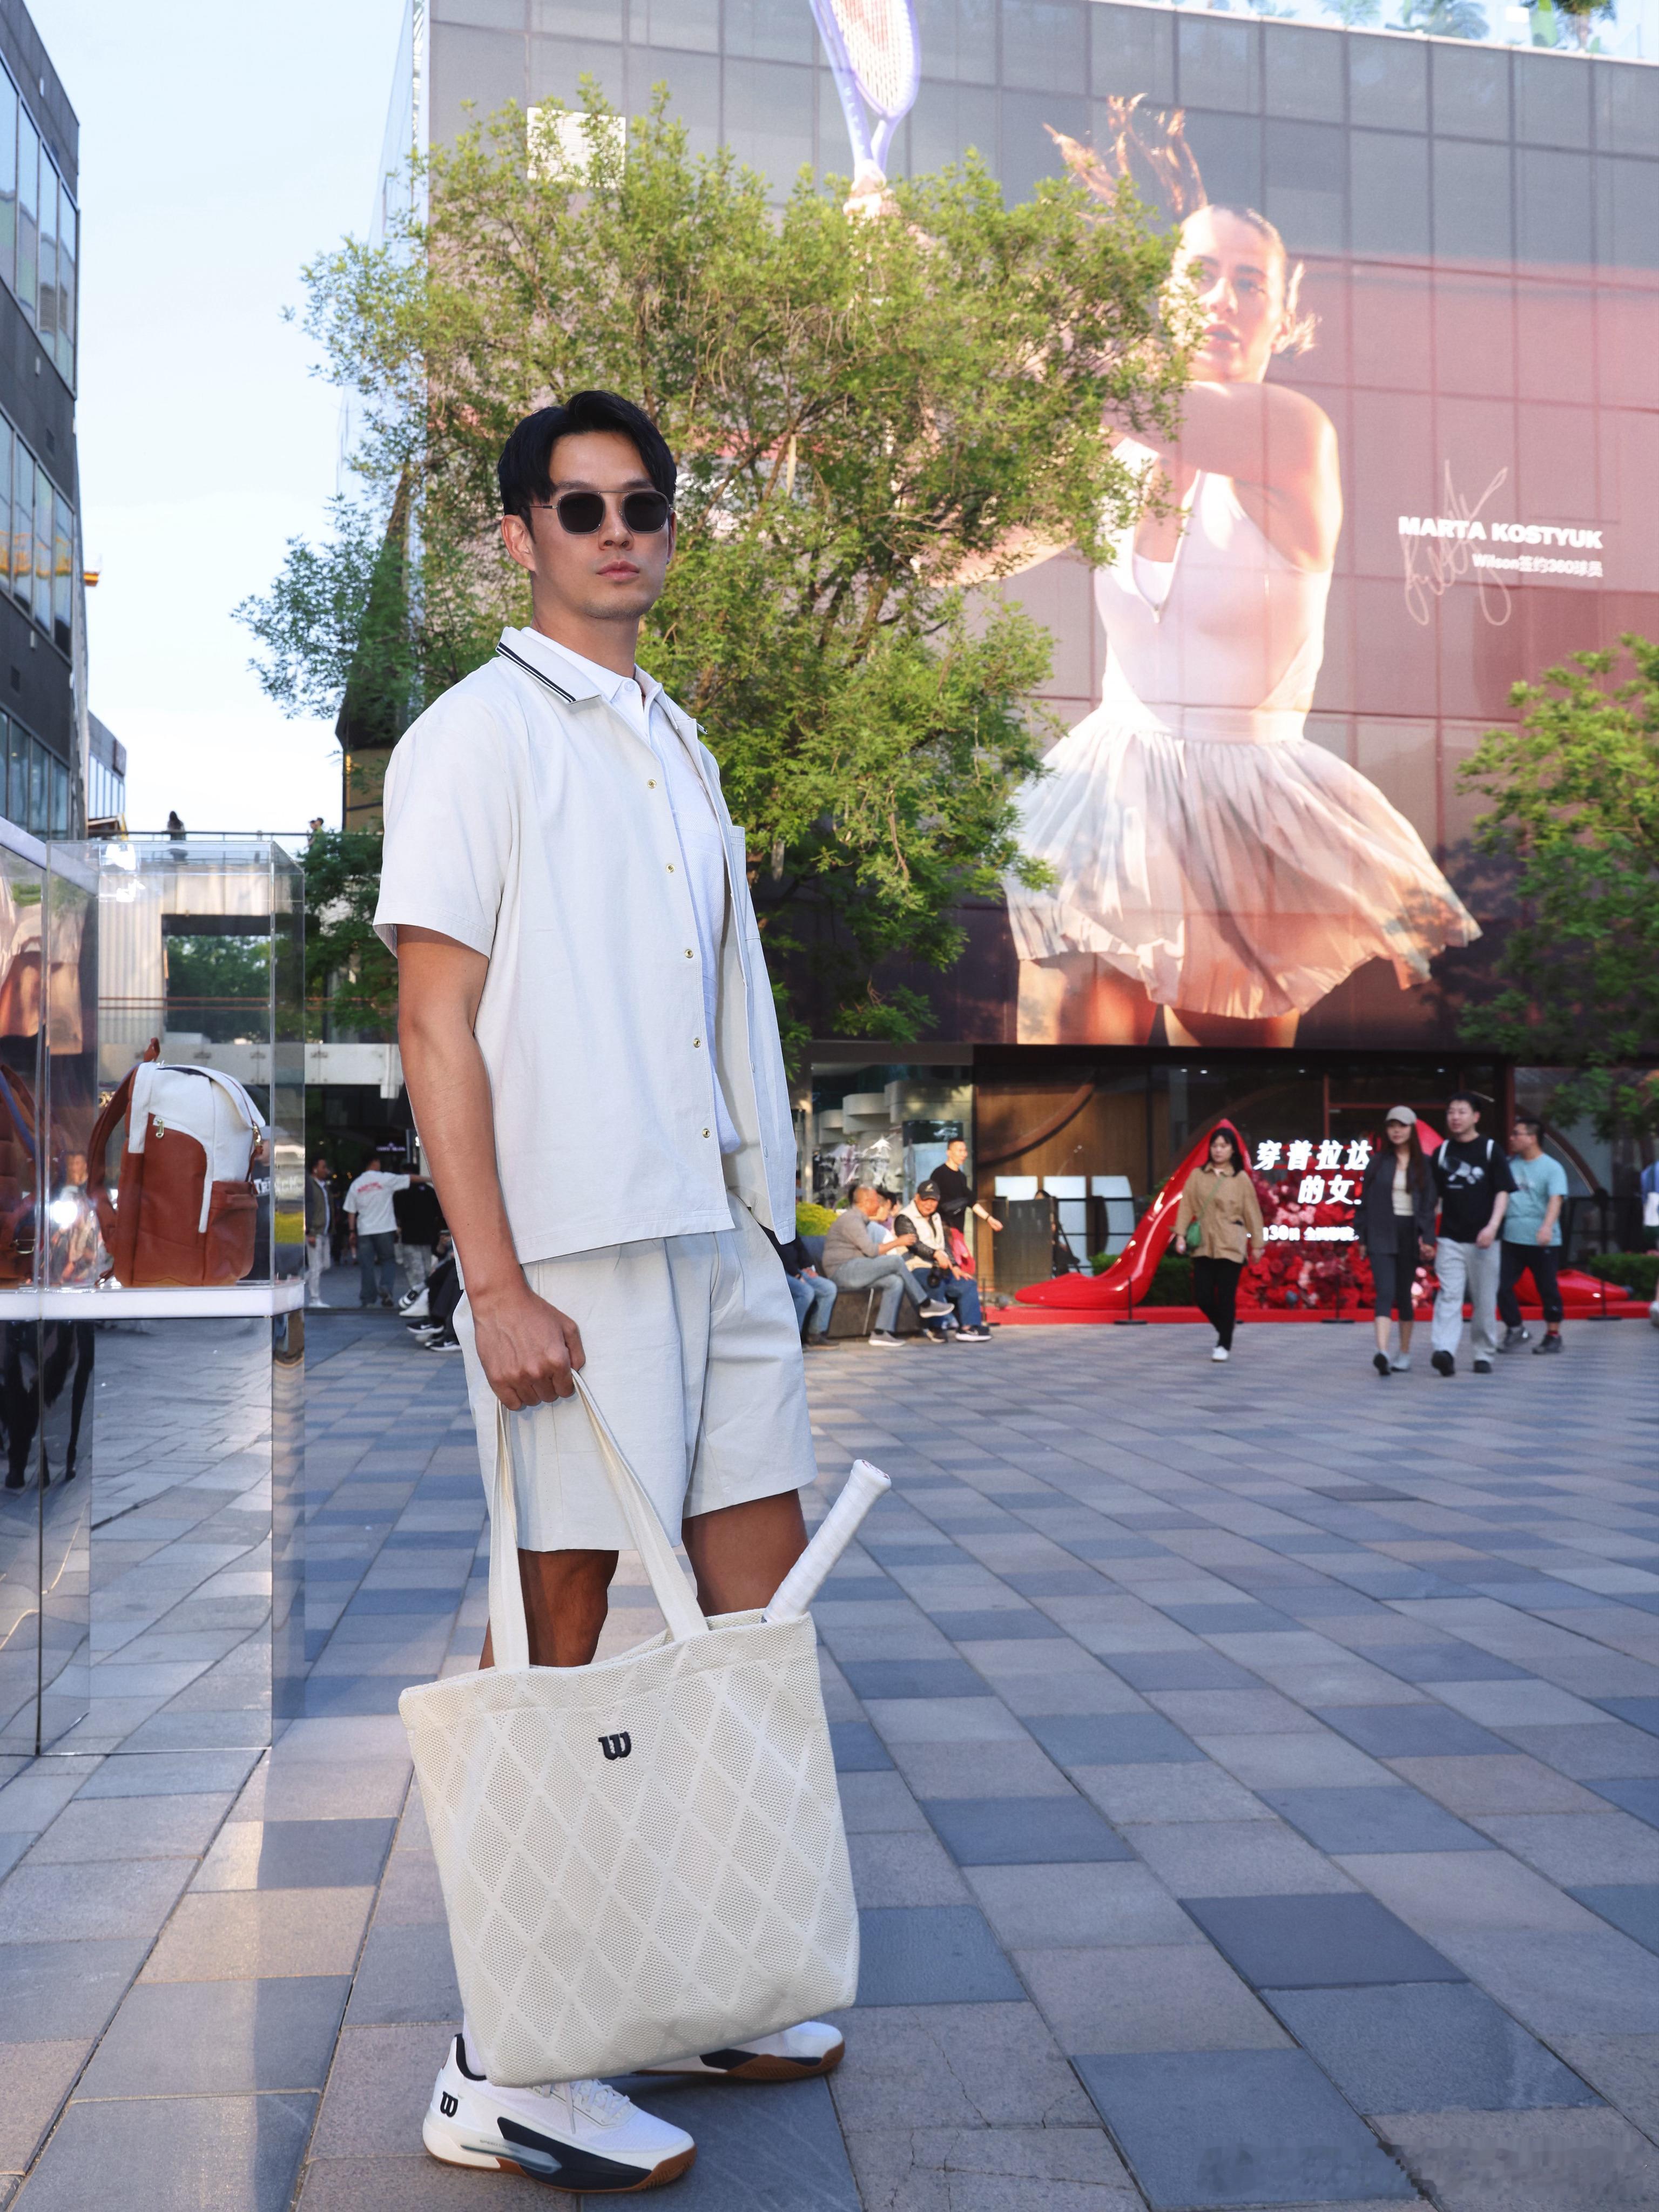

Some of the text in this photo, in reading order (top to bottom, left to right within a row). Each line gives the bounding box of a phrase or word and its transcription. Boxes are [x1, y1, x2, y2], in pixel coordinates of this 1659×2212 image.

[1399, 516, 1603, 549] MARTA KOSTYUK
[1253, 1139, 1373, 1170] 穿普拉达
[1298, 1174, 1362, 1205] 的女
